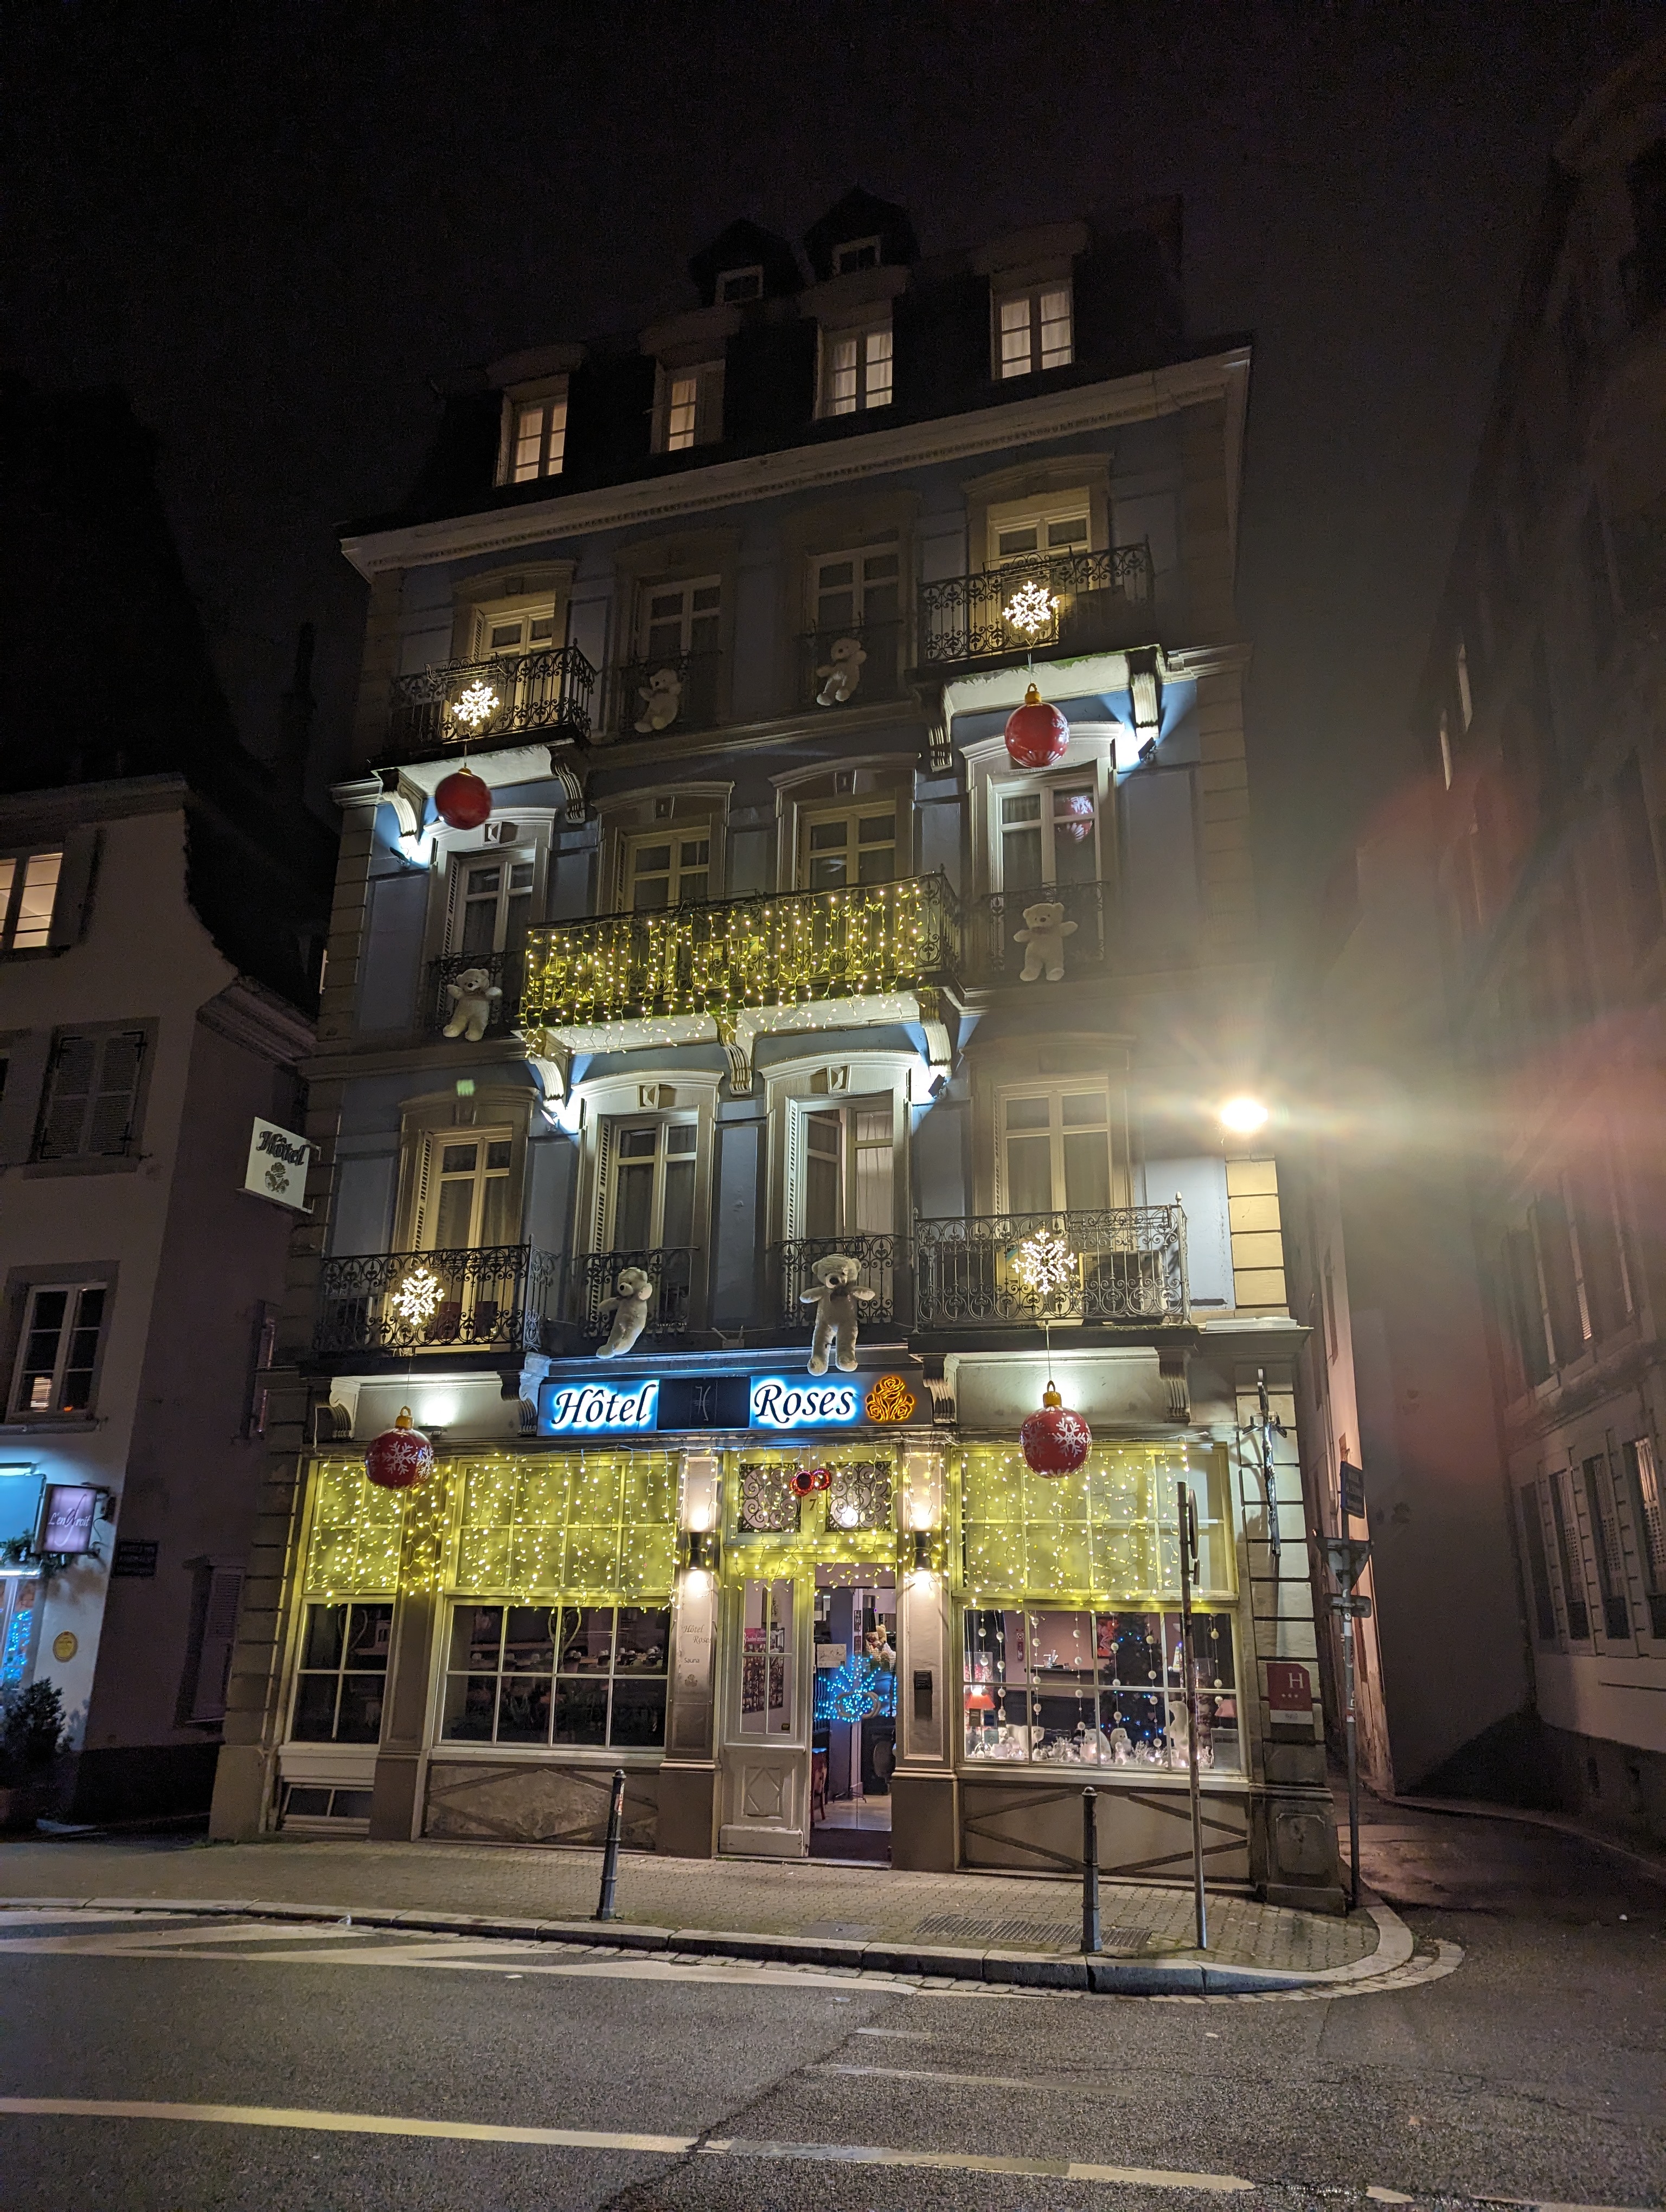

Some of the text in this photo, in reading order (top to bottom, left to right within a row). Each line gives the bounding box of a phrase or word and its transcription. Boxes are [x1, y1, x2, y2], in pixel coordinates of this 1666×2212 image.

[256, 1131, 310, 1166] Hôtel
[551, 1384, 657, 1424] Hôtel
[754, 1384, 853, 1424] Roses
[683, 1624, 704, 1633] Hôtel
[693, 1635, 712, 1644] Roses
[1289, 1673, 1304, 1688] H
